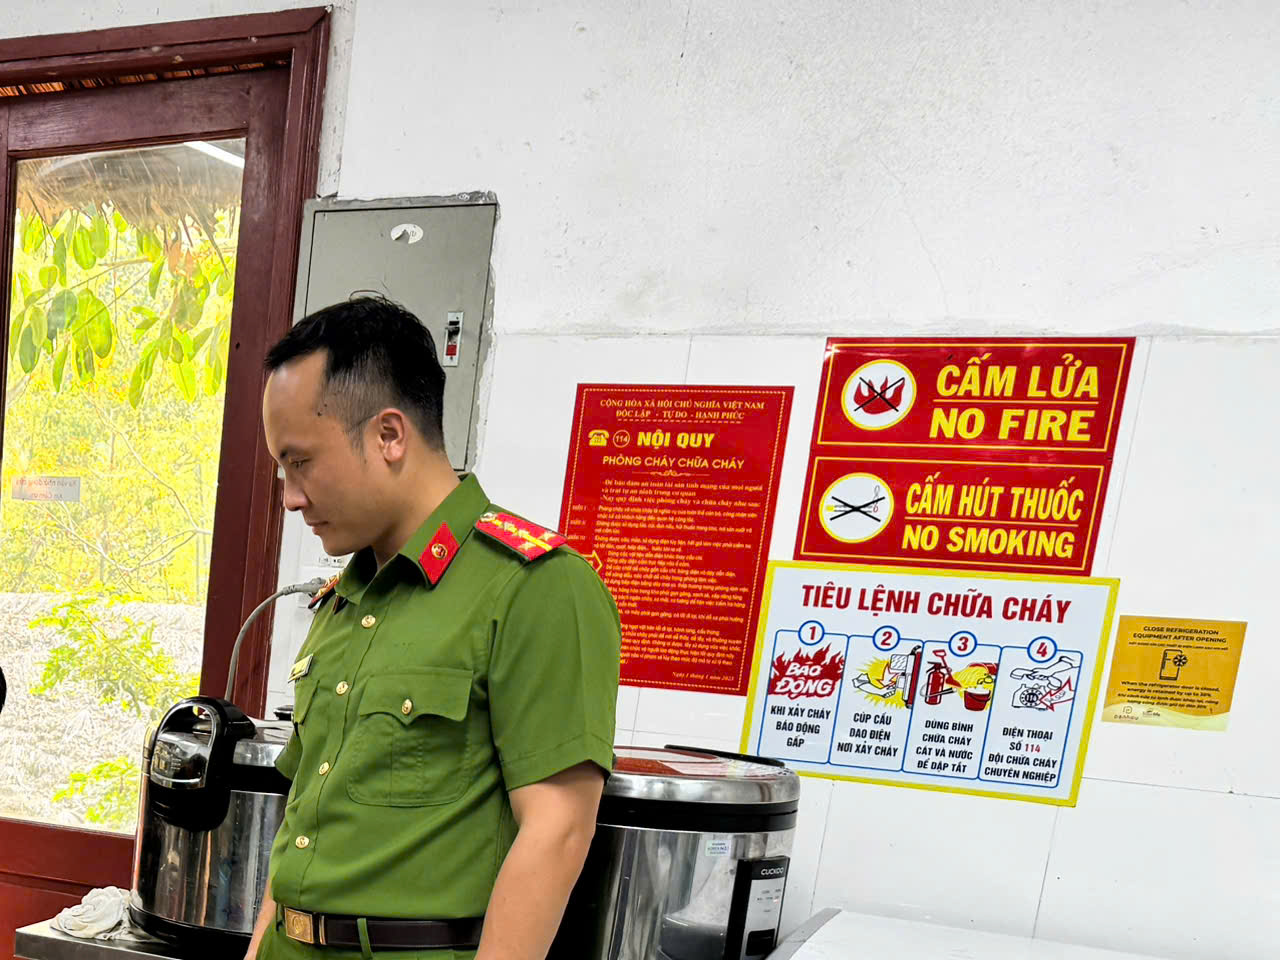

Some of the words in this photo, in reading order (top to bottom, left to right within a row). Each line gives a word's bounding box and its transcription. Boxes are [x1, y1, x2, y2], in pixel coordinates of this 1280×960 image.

[936, 352, 1017, 397] CẤM
[1027, 353, 1098, 398] LỬA
[657, 399, 672, 409] HỘI
[744, 401, 765, 409] NAM
[675, 410, 688, 419] DO
[929, 408, 986, 439] NO
[998, 409, 1096, 441] FIRE
[637, 428, 671, 449] NỘI
[677, 431, 715, 448] QUY
[603, 454, 641, 466] PHÒNG
[644, 455, 676, 467] CHÁY
[678, 456, 709, 468] CHỮA
[712, 457, 745, 469] CHÁY
[905, 471, 954, 515] CẤM
[958, 477, 1004, 517] HÚT
[1010, 476, 1084, 521] THUỐC
[902, 524, 939, 550] NO
[946, 526, 1075, 559] SMOKING
[802, 581, 852, 609] TIÊU
[857, 584, 920, 616] LỆNH
[927, 588, 993, 619] CHỮA
[1002, 594, 1072, 624] CHÁY
[809, 626, 817, 641] 1
[880, 631, 893, 646] 2
[957, 636, 969, 651] 3
[1036, 642, 1048, 658] 4
[775, 677, 833, 698] ĐỘNG
[770, 705, 786, 715] KHI
[788, 703, 805, 717] XẢY
[807, 708, 831, 719] CHÁY
[776, 719, 793, 731] BÁO
[796, 721, 821, 735] ĐỘNG
[925, 718, 949, 730] DÙNG
[951, 721, 973, 732] BÌNH
[786, 734, 805, 747] GẤP
[849, 728, 867, 738] DAO
[869, 728, 891, 742] ĐIỆN
[922, 733, 945, 743] CHỮA
[948, 735, 972, 746] CHÁY
[1002, 726, 1024, 738] ĐIỆN
[1026, 729, 1053, 742] THOẠI
[837, 741, 853, 752] NƠI
[854, 740, 872, 754] XẢY
[874, 744, 898, 757] CHÁY
[916, 745, 933, 756] CÁT
[935, 747, 946, 757] VÀ
[948, 749, 973, 760] NƯỚC
[1009, 739, 1023, 751] SỐ
[1025, 743, 1041, 753] 114
[988, 752, 1004, 765] ĐỘI
[1006, 754, 1030, 766] CHỮA
[1033, 757, 1057, 768] CHÁY
[984, 767, 1020, 778] CHUYÊN
[1022, 771, 1056, 783] NGHIỆP
[761, 867, 785, 876] CUCKOO
